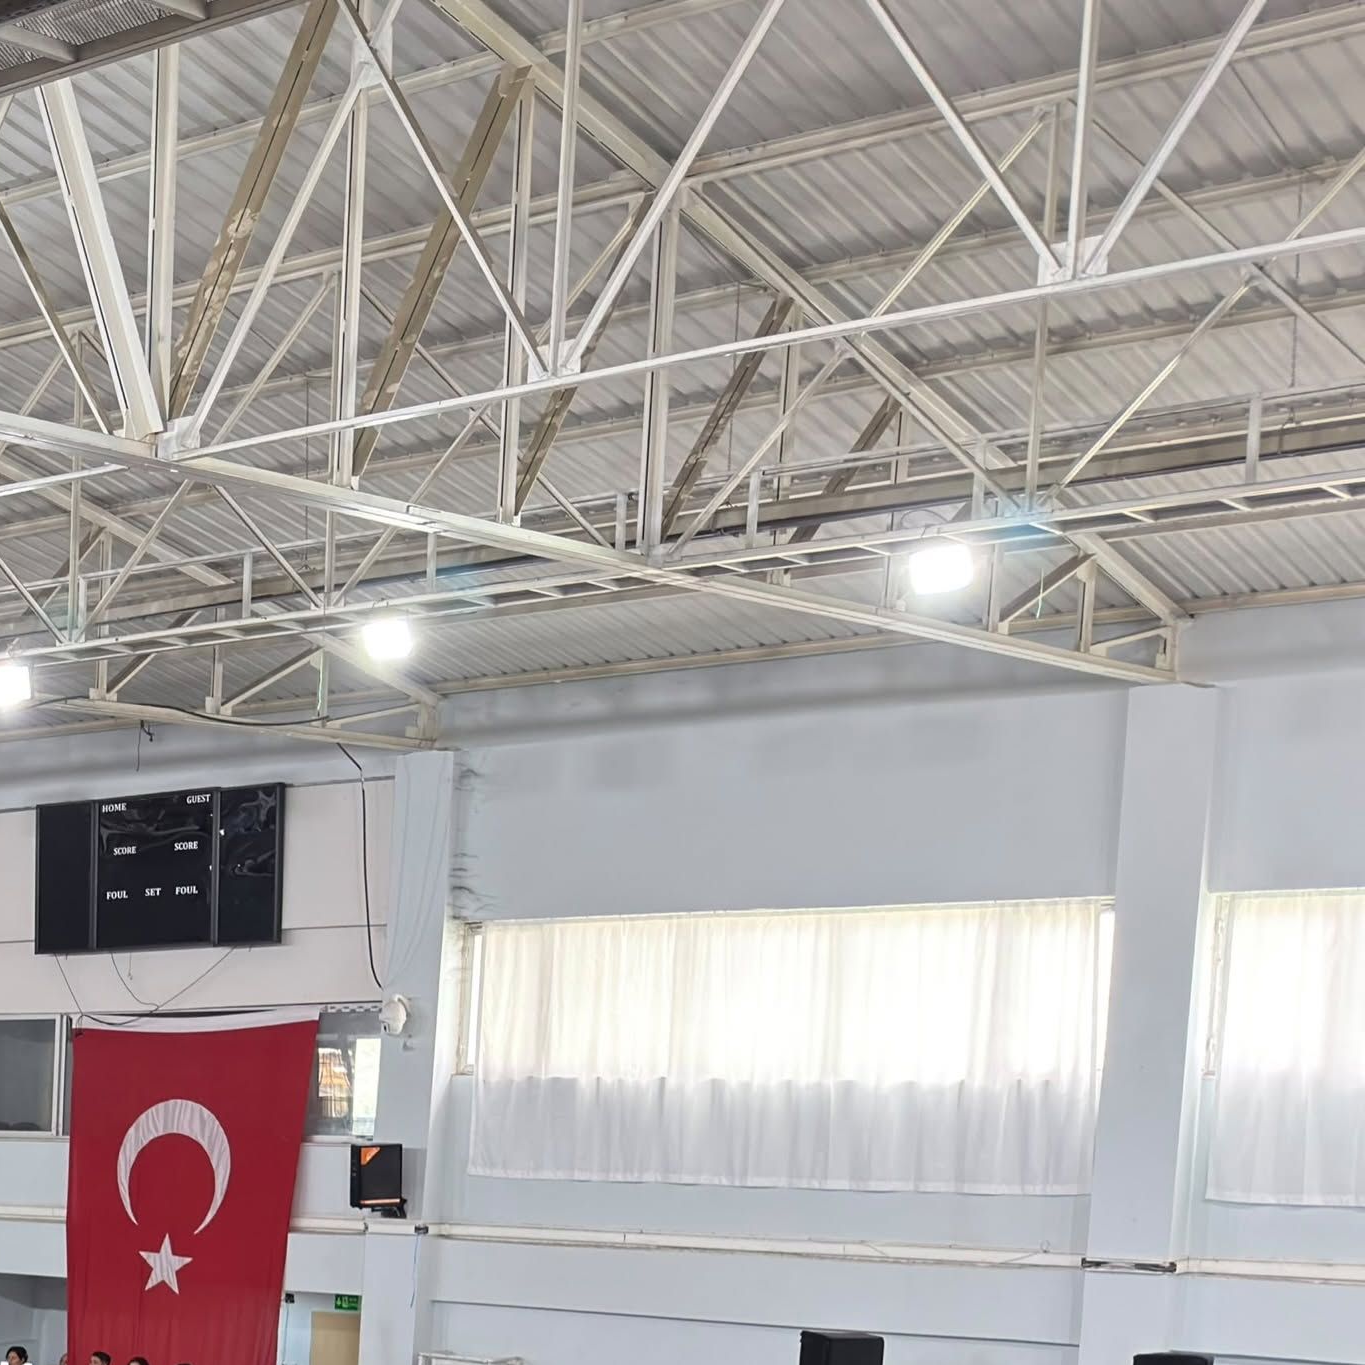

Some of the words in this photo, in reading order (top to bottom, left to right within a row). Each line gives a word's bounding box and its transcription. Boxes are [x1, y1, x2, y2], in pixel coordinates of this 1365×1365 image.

[186, 794, 211, 804] GUEST
[102, 802, 127, 813] HOME
[113, 846, 137, 856] SCORE
[174, 841, 199, 851] SCORE
[106, 890, 128, 900] FOUL
[144, 887, 162, 897] SET
[175, 885, 199, 895] FOUL
